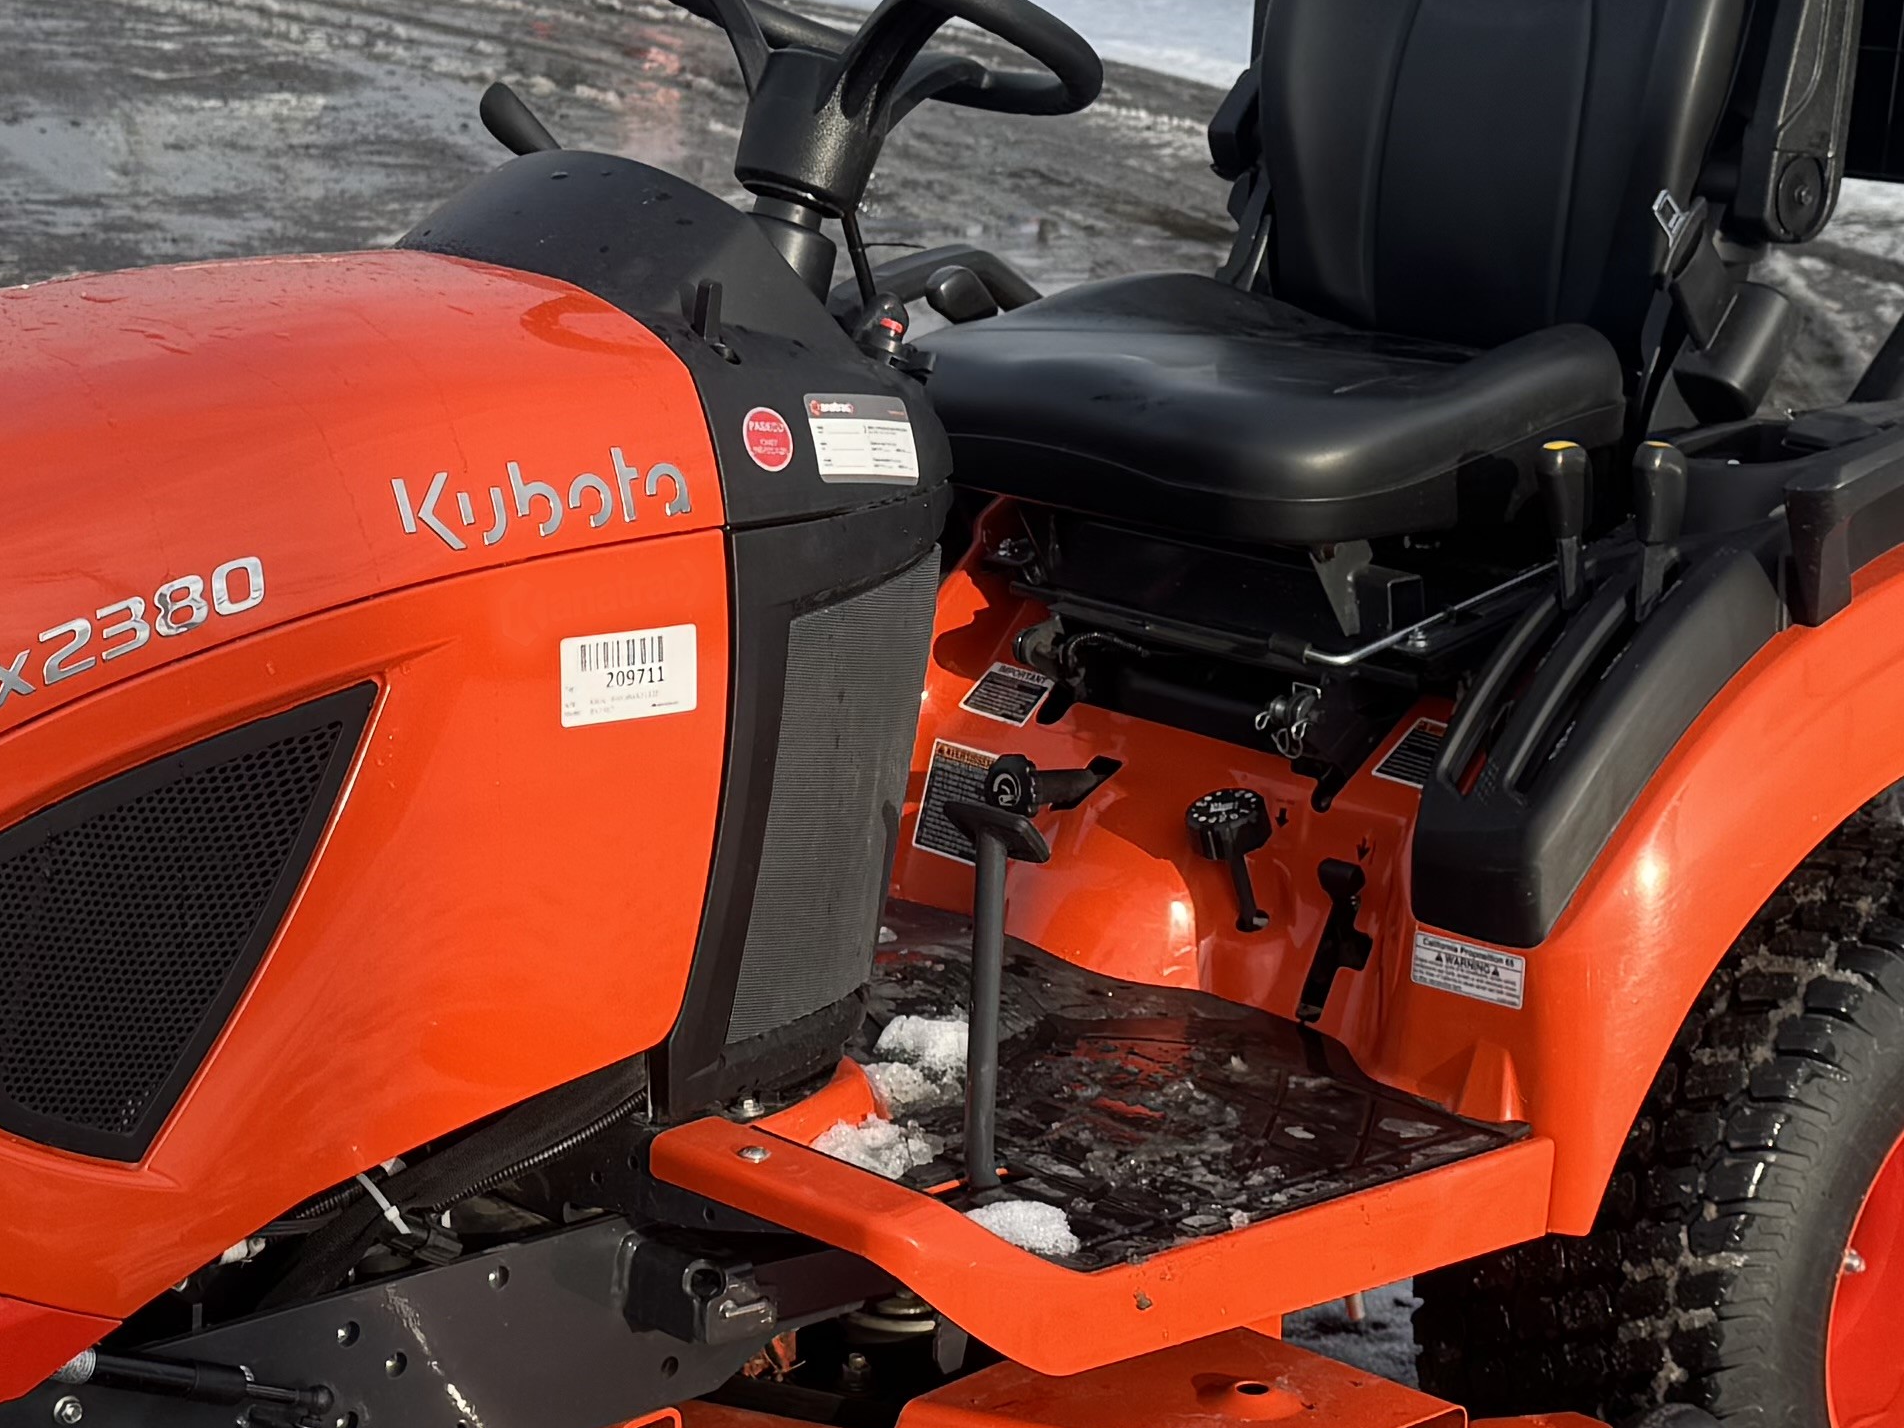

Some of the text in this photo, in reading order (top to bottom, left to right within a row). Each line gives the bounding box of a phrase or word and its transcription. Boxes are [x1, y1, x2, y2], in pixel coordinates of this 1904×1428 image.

[390, 446, 692, 550] Kubota
[606, 665, 665, 689] 209711
[998, 665, 1049, 685] IMPORTANT
[1445, 953, 1491, 975] WARNING
[1460, 946, 1504, 964] Proposition
